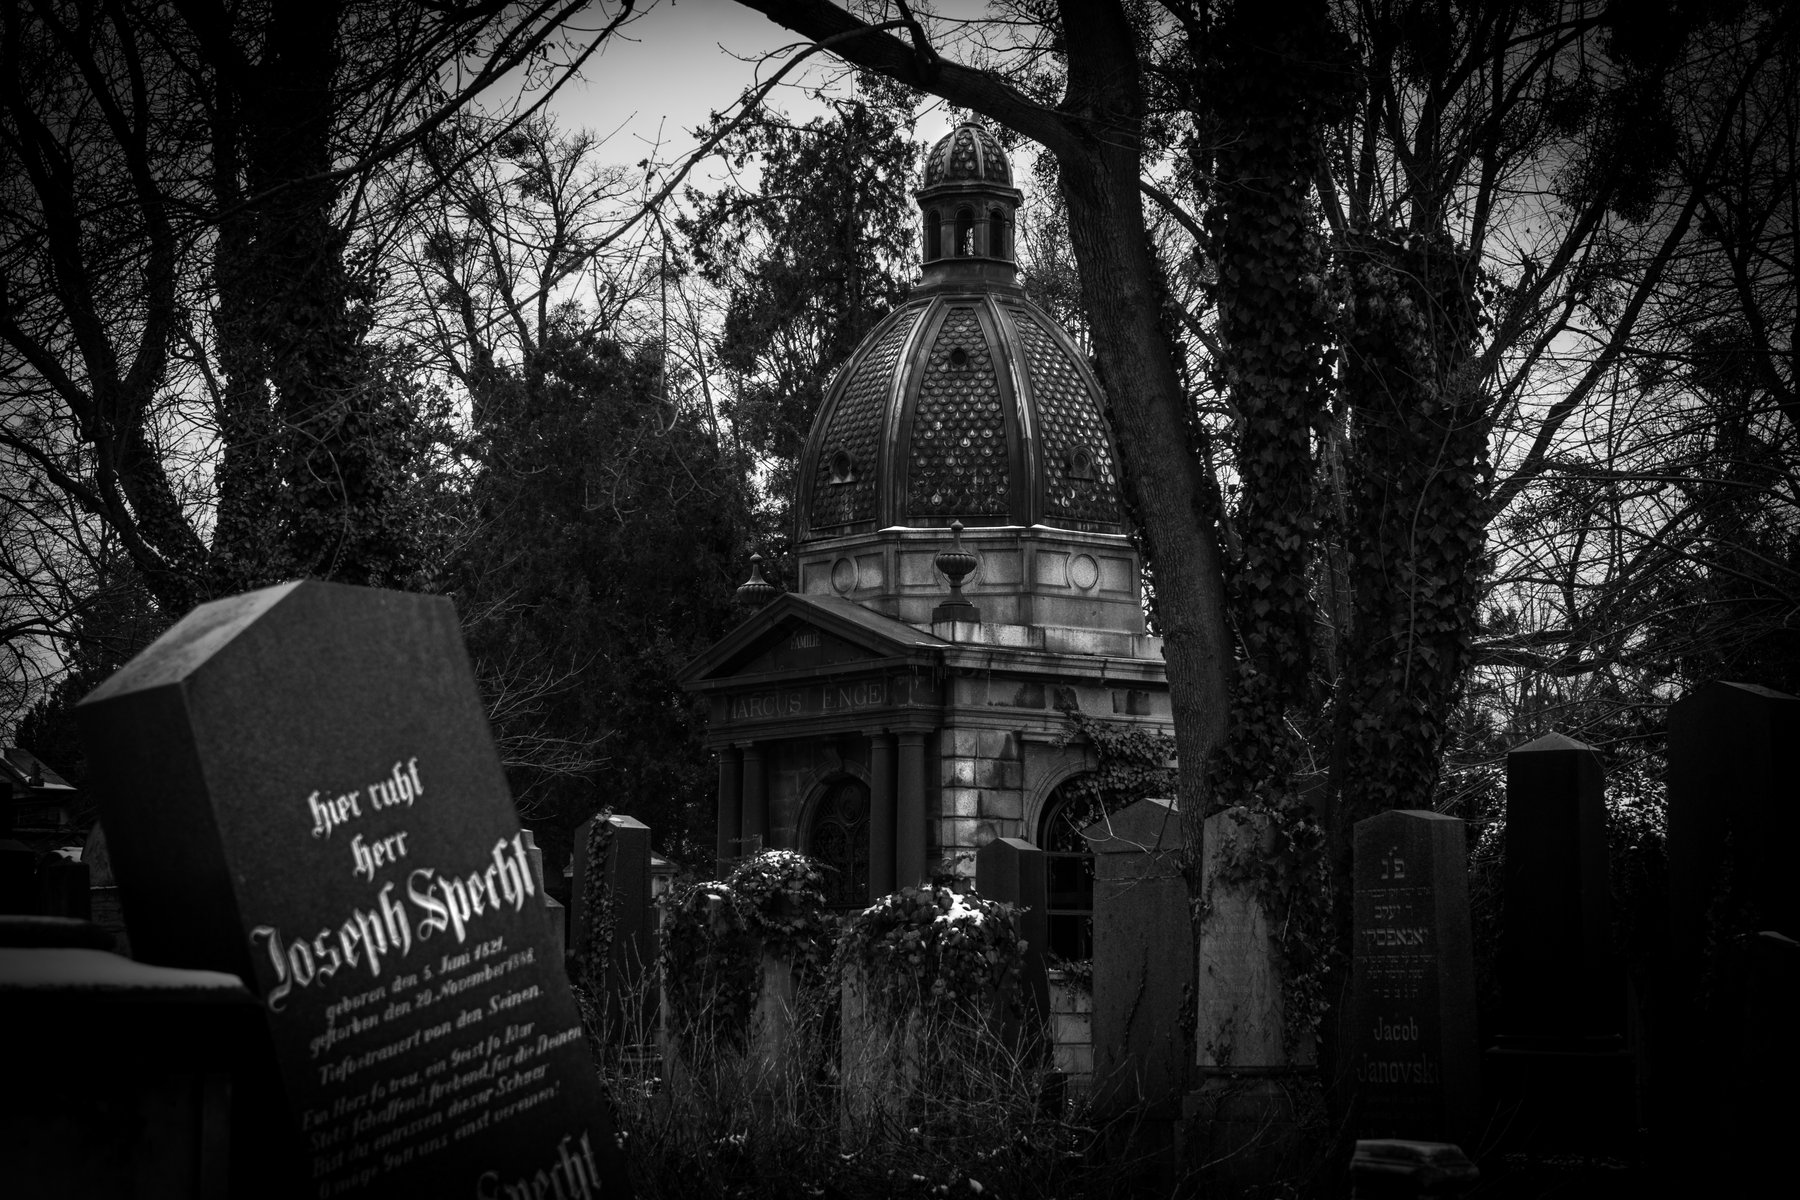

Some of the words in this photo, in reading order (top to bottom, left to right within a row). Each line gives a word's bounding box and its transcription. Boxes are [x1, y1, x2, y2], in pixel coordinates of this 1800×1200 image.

[790, 631, 822, 650] FAMILIE
[367, 756, 425, 811] ruht
[249, 881, 412, 1014] Joseph
[406, 832, 536, 945] Specht
[325, 986, 386, 1030] geboren
[391, 974, 418, 994] den
[438, 946, 470, 975] Juni
[383, 1001, 411, 1021] den
[434, 963, 509, 1001] November
[424, 1021, 452, 1043] von
[456, 1008, 483, 1030] den
[536, 1025, 583, 1057] Deinen
[1373, 1016, 1419, 1041] Jacob
[1356, 1052, 1440, 1084] Janovski
[301, 1108, 330, 1133] Ein
[425, 1057, 447, 1079] ein
